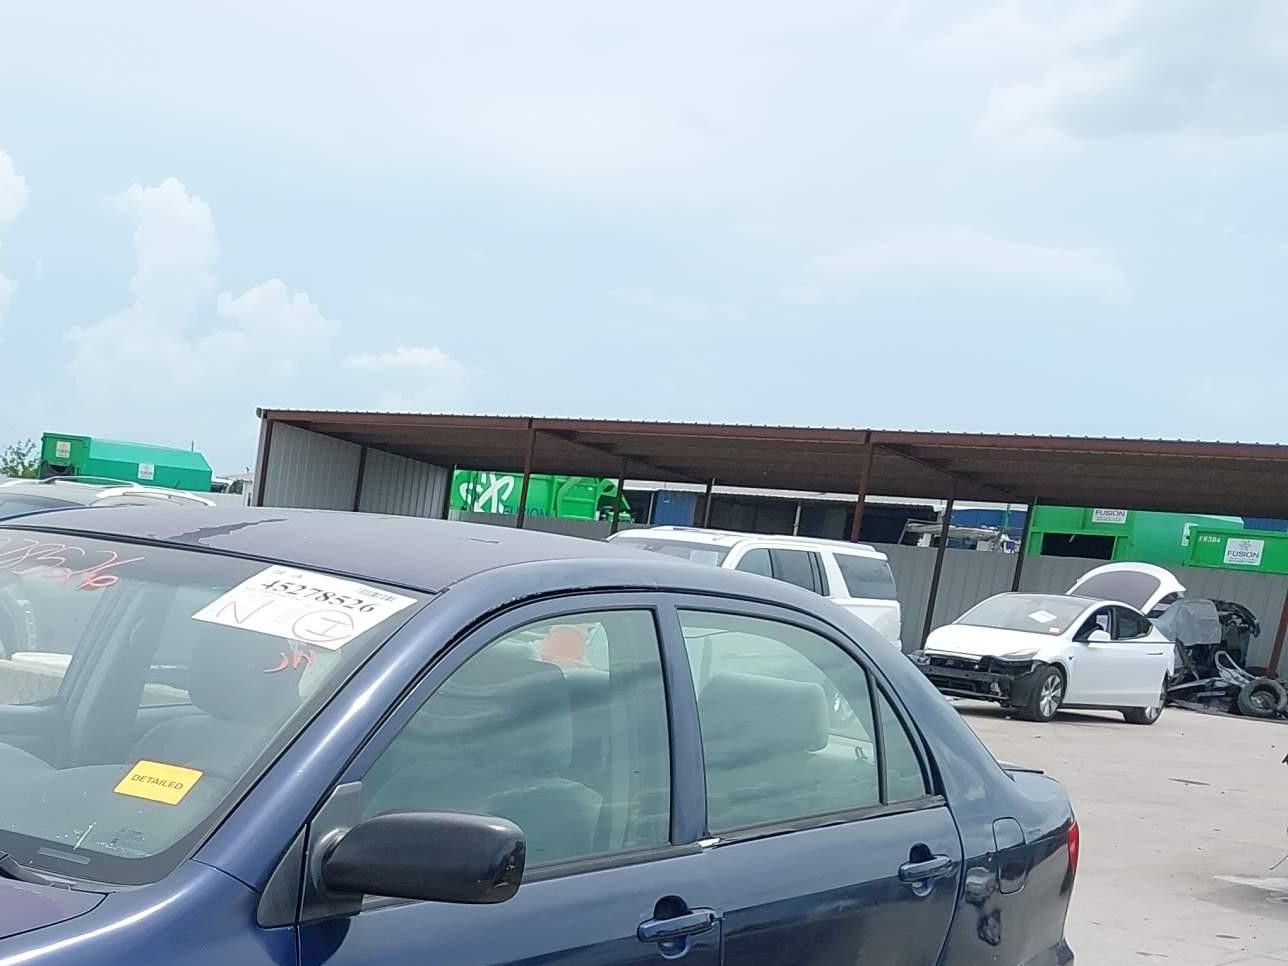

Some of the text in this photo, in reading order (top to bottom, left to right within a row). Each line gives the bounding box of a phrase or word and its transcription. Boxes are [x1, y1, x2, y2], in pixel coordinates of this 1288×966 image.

[1095, 509, 1126, 517] FUSION
[1227, 550, 1259, 558] FUSION
[262, 580, 376, 613] 45278526
[131, 774, 184, 790] DETAILED
